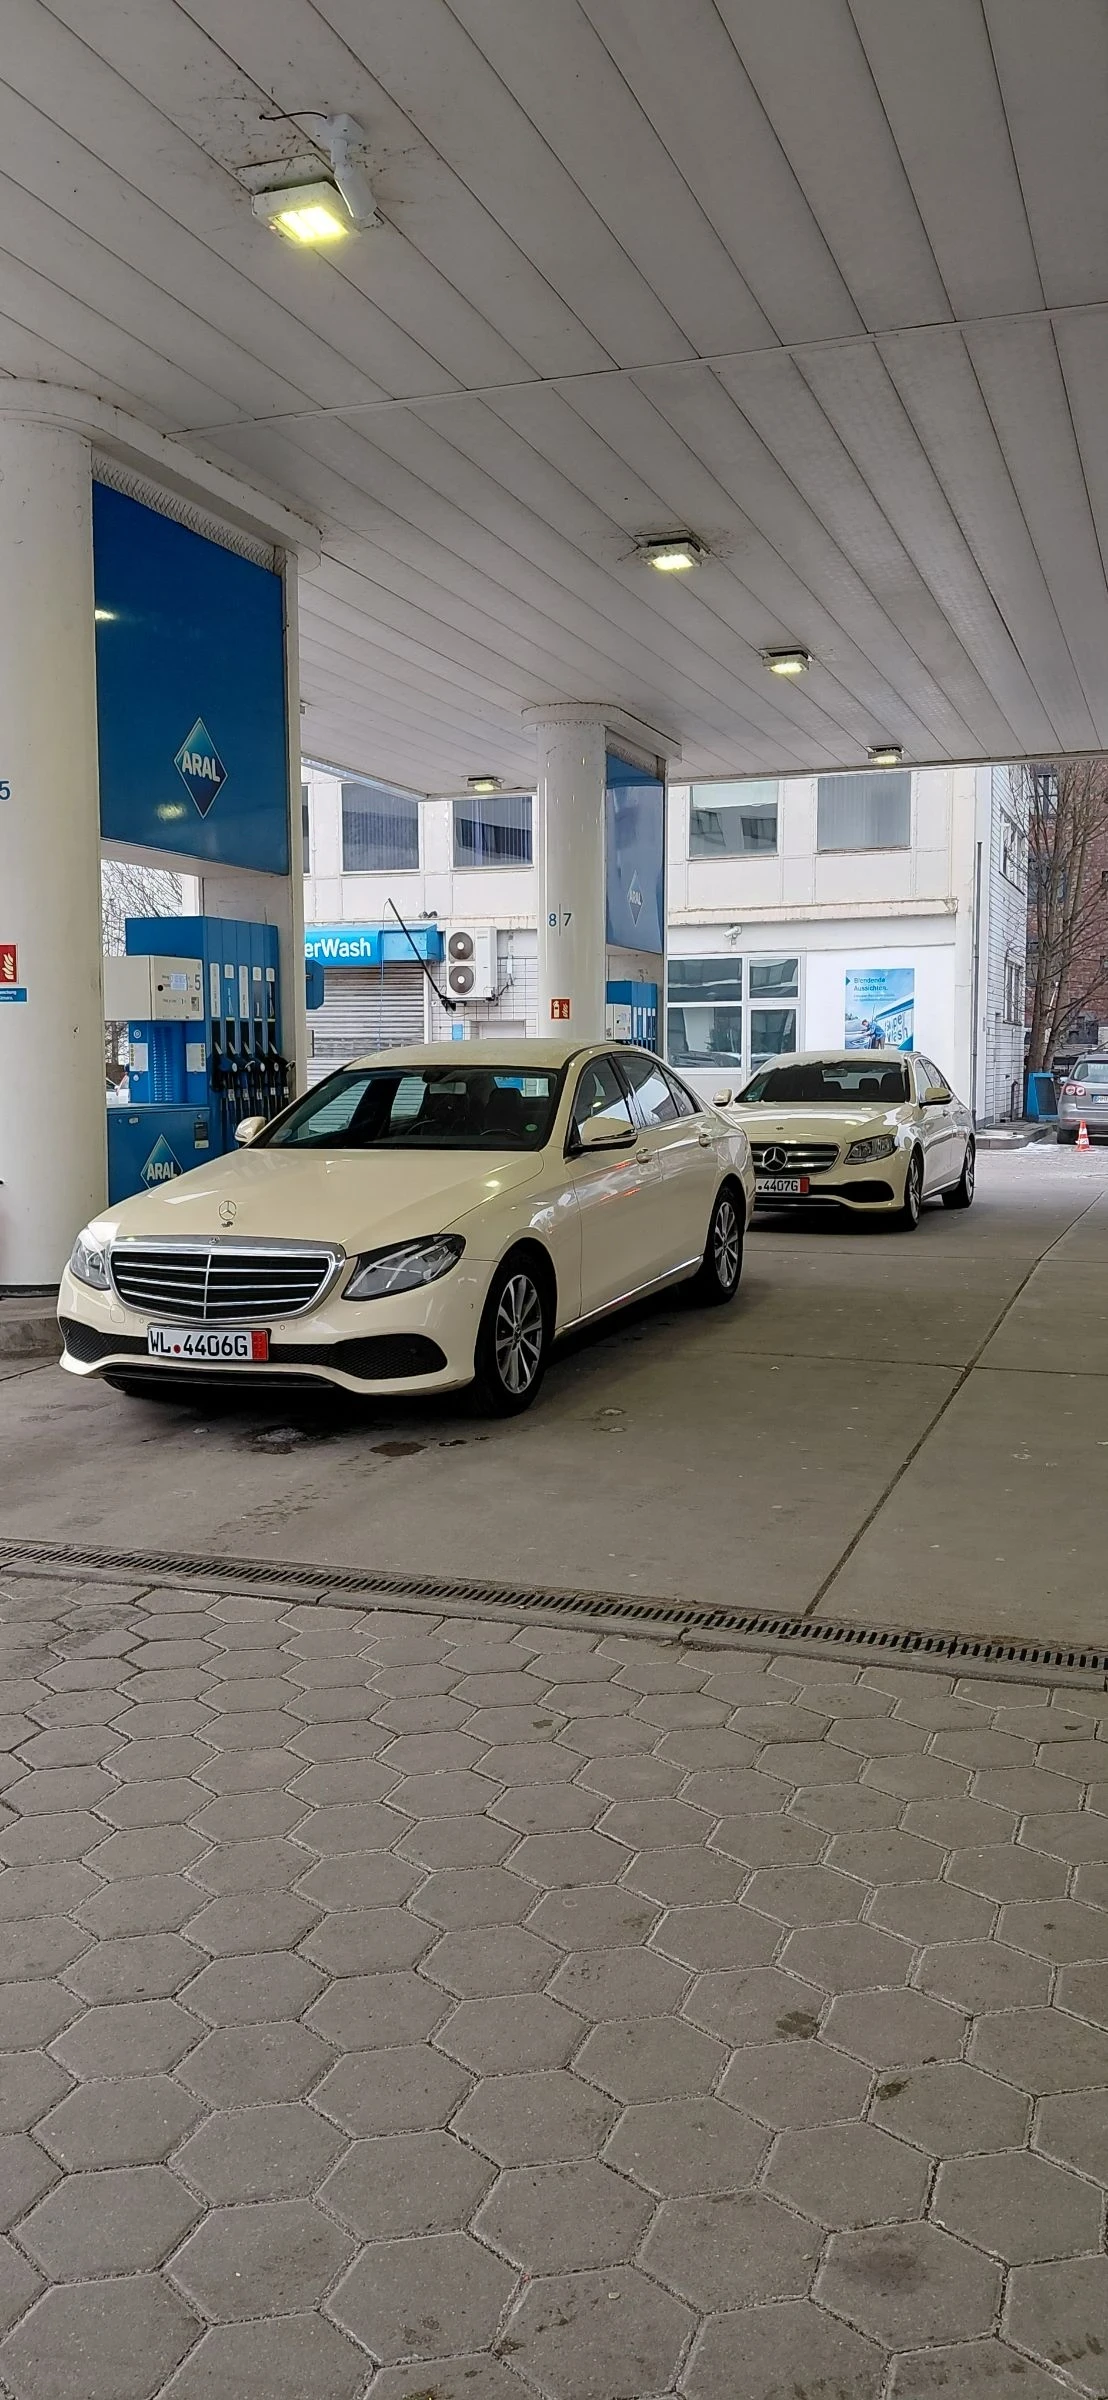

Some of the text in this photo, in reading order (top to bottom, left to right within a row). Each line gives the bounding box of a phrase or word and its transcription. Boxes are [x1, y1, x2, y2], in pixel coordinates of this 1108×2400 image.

[182, 750, 221, 782] ARAL
[629, 889, 642, 906] ARAL
[548, 912, 572, 927] 8 7
[304, 937, 372, 959] erWash
[194, 974, 201, 991] 5
[146, 1161, 178, 1181] ARAL
